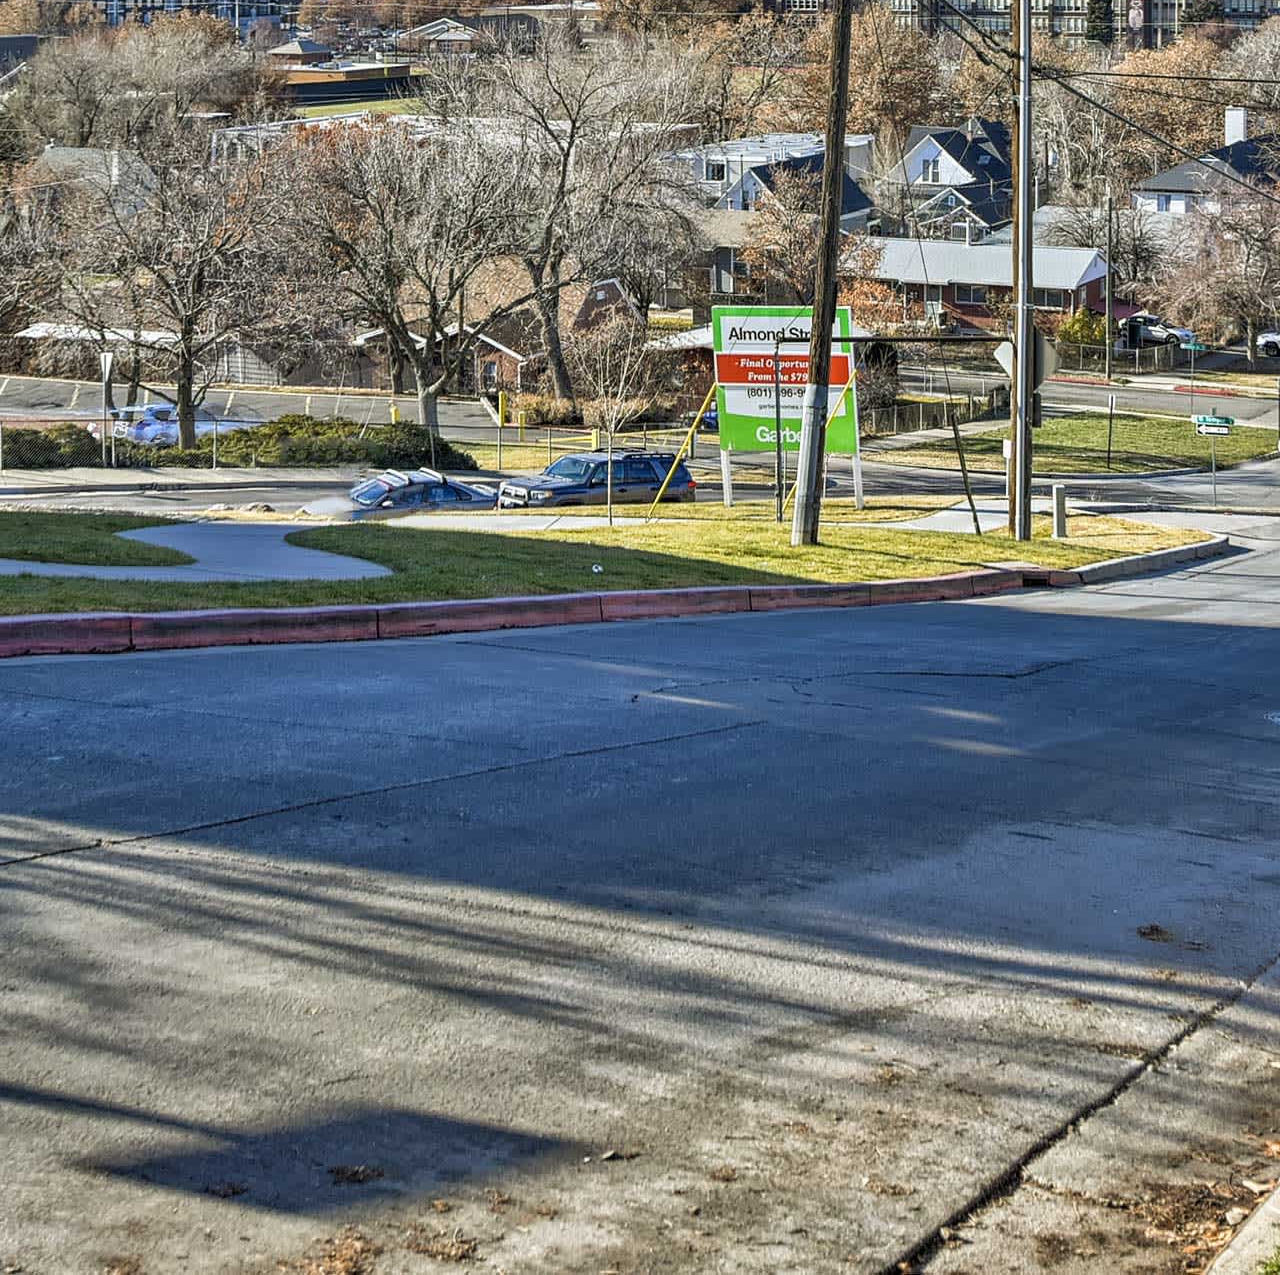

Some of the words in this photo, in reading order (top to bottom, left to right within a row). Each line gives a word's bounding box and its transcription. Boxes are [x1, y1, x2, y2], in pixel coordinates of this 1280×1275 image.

[728, 327, 785, 341] Almond
[740, 358, 765, 368] Final
[747, 371, 772, 382] From
[747, 387, 772, 399] (801)
[776, 388, 807, 399] 96-9
